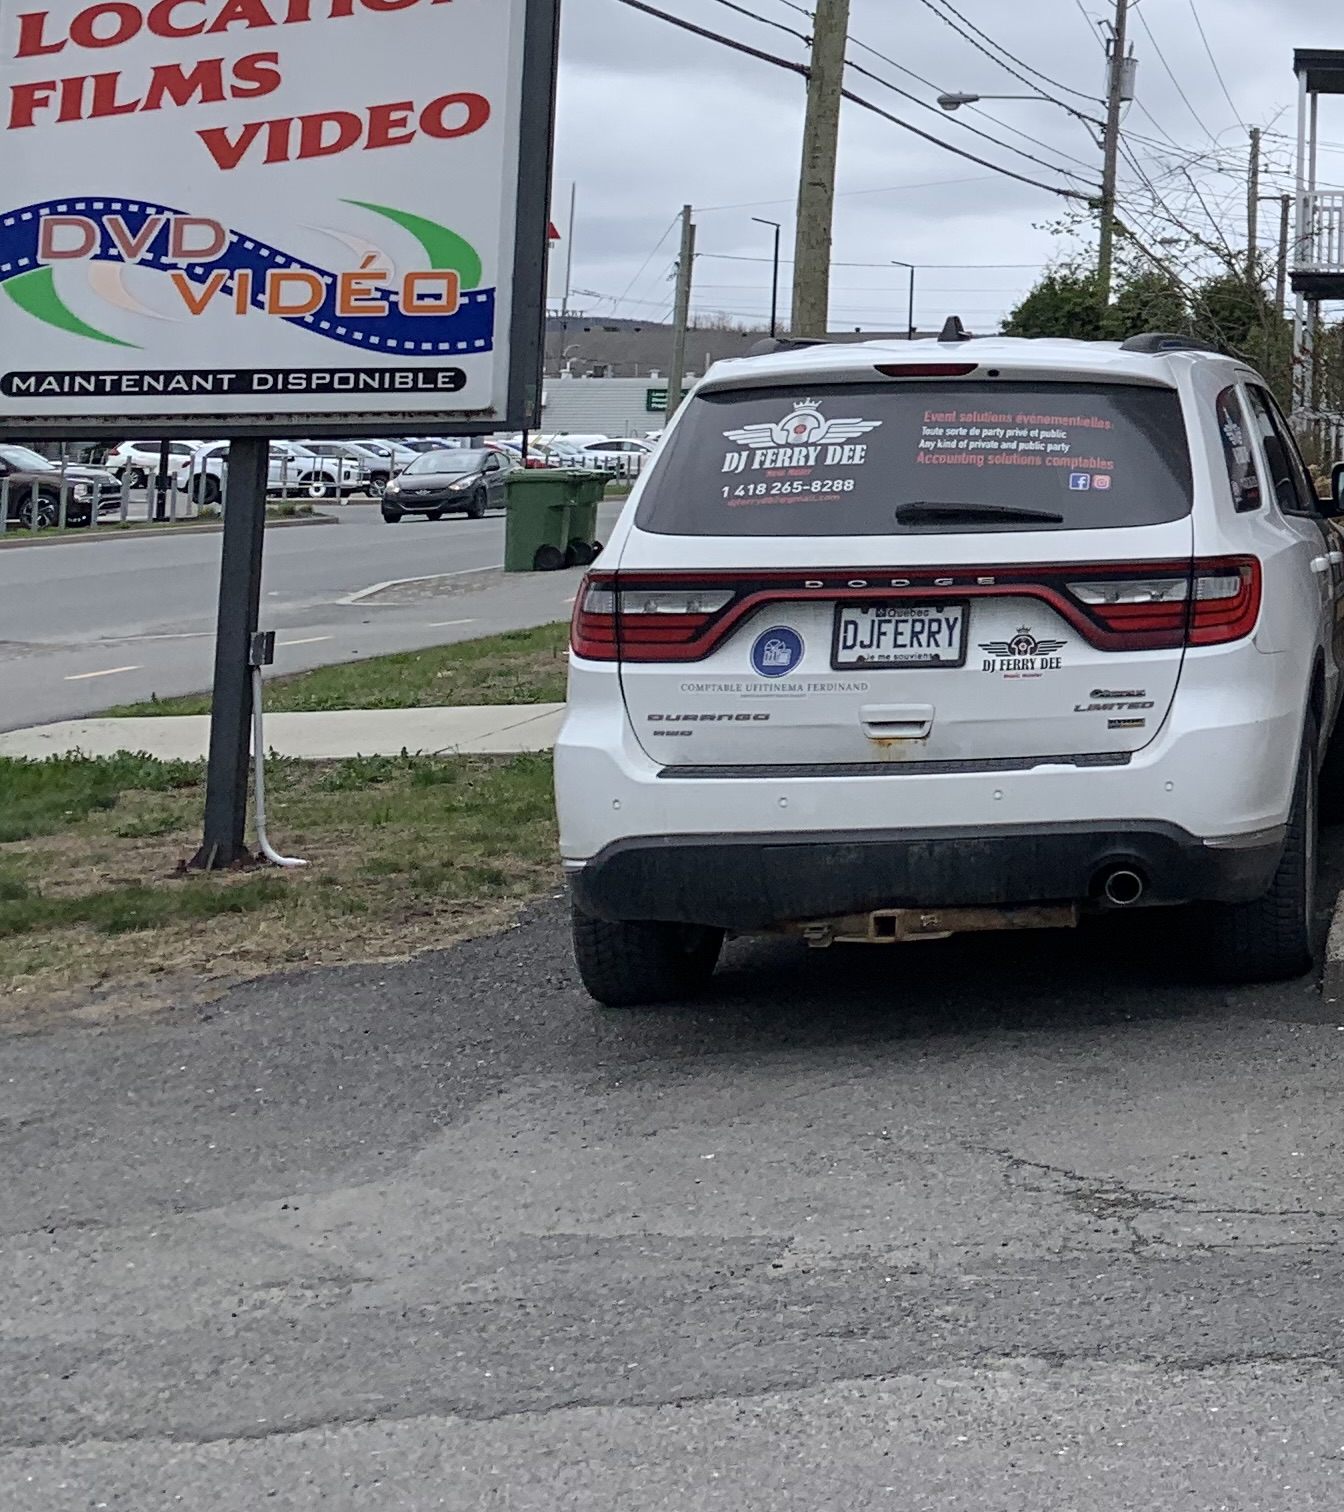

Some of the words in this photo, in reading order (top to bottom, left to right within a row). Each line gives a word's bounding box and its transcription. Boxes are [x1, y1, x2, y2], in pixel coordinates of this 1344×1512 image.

[7, 51, 282, 130] FILMS
[196, 92, 491, 170] VIDEO
[37, 214, 232, 264] DVD
[170, 251, 463, 317] VIDÉO
[11, 374, 236, 393] MAINTENANT
[251, 371, 457, 392] DISPONIBLE
[923, 410, 957, 423] Event
[959, 411, 1013, 423] solutions
[922, 426, 944, 436] Toute
[945, 426, 968, 436] sorte
[969, 426, 981, 436] de
[981, 427, 1005, 439] party
[1005, 427, 1028, 439] privé
[1029, 428, 1039, 437] et
[1039, 428, 1067, 440] public
[918, 439, 936, 451] Any
[936, 439, 957, 449] kind
[958, 439, 969, 449] of
[968, 439, 999, 451] private
[999, 440, 1018, 450] and
[1018, 440, 1046, 452] public
[1046, 442, 1071, 454] party
[721, 450, 750, 473] DJ
[751, 445, 822, 470] FERRY
[824, 444, 867, 466] DEE
[917, 450, 985, 468] Accounting
[987, 452, 1042, 465] solutions
[1045, 455, 1114, 470] comptables
[721, 486, 730, 498] 1
[734, 482, 767, 498] 418
[770, 478, 855, 495] 265-8288
[804, 576, 996, 590] DODGE
[842, 617, 959, 651] DJFERRY
[982, 659, 996, 673] DJ
[1000, 658, 1036, 671] FERRY
[1039, 657, 1062, 670] DEE
[680, 682, 742, 692] COMPTABLE
[807, 681, 868, 691] FERDINAND
[1073, 701, 1155, 712] LIMITED
[647, 713, 770, 722] DURANGO
